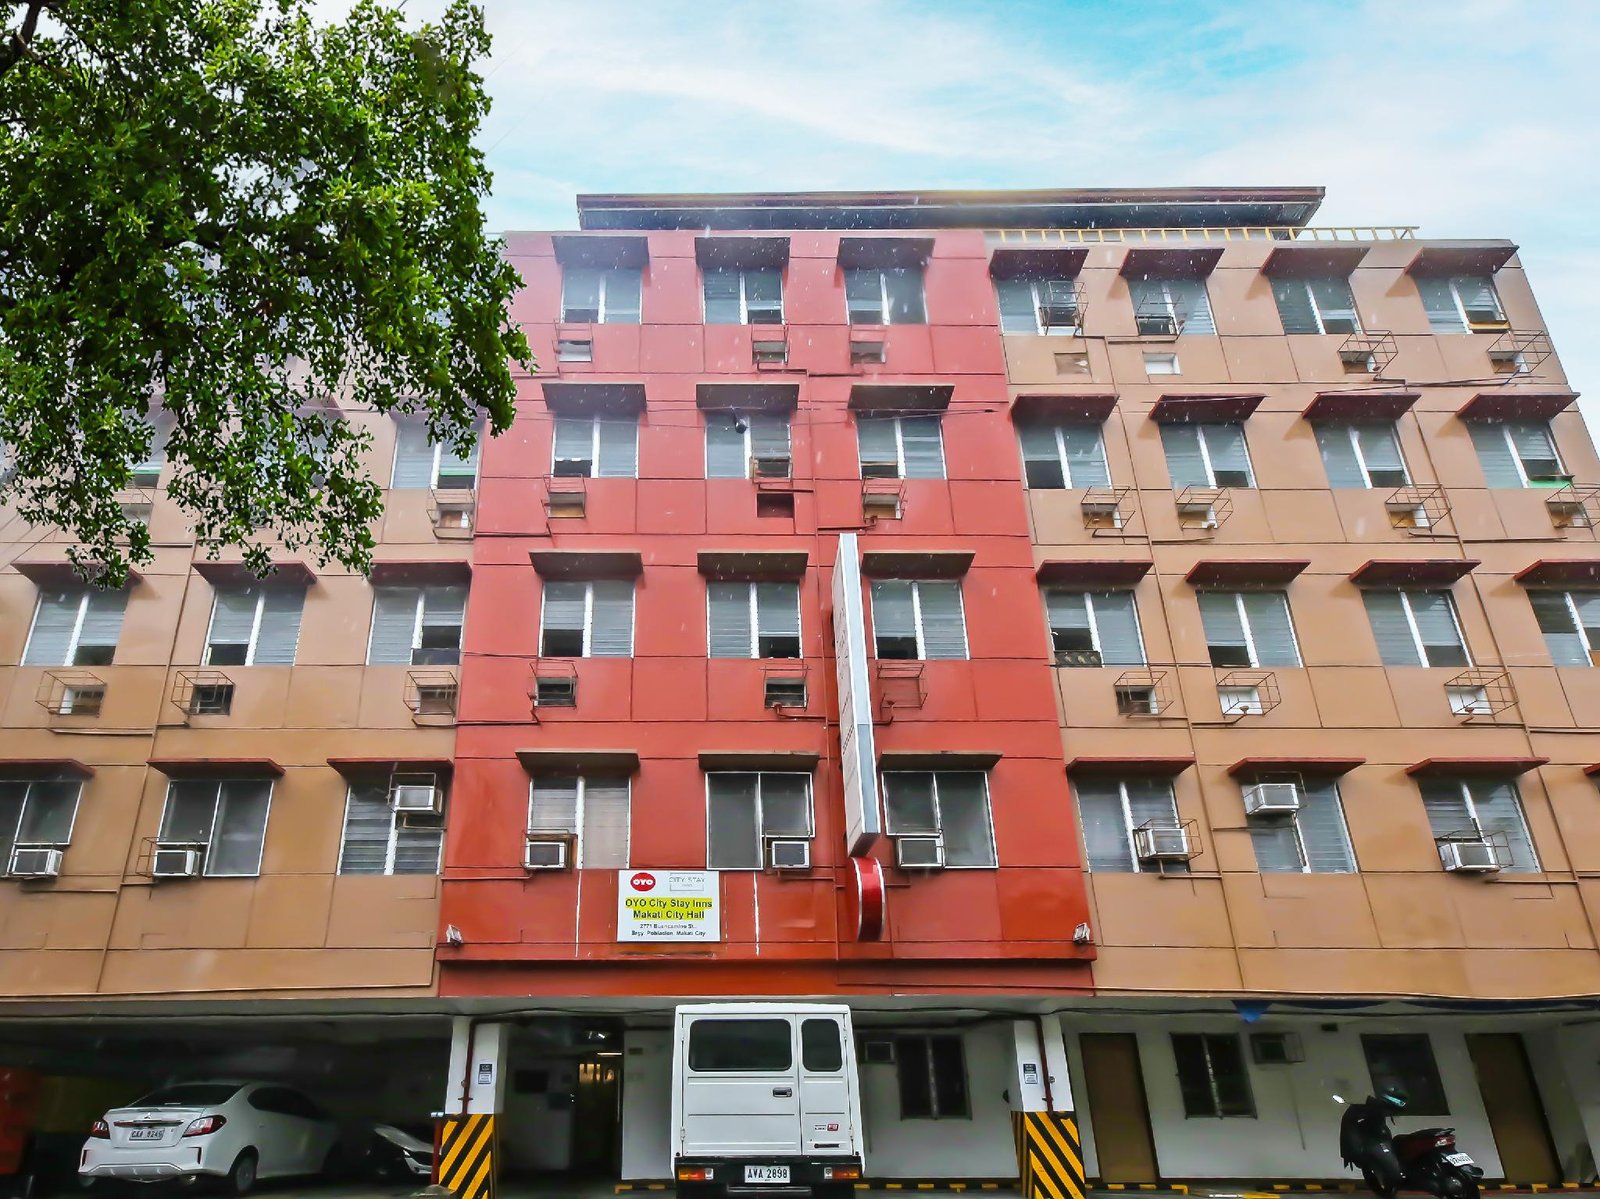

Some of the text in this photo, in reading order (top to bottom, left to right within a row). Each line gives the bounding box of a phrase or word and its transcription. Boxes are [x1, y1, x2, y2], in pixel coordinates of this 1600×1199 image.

[632, 878, 654, 886] OYO
[625, 898, 713, 909] OYO City Stay Inns
[633, 910, 705, 920] Makati City Hall
[747, 1168, 788, 1179] AVA 2898
